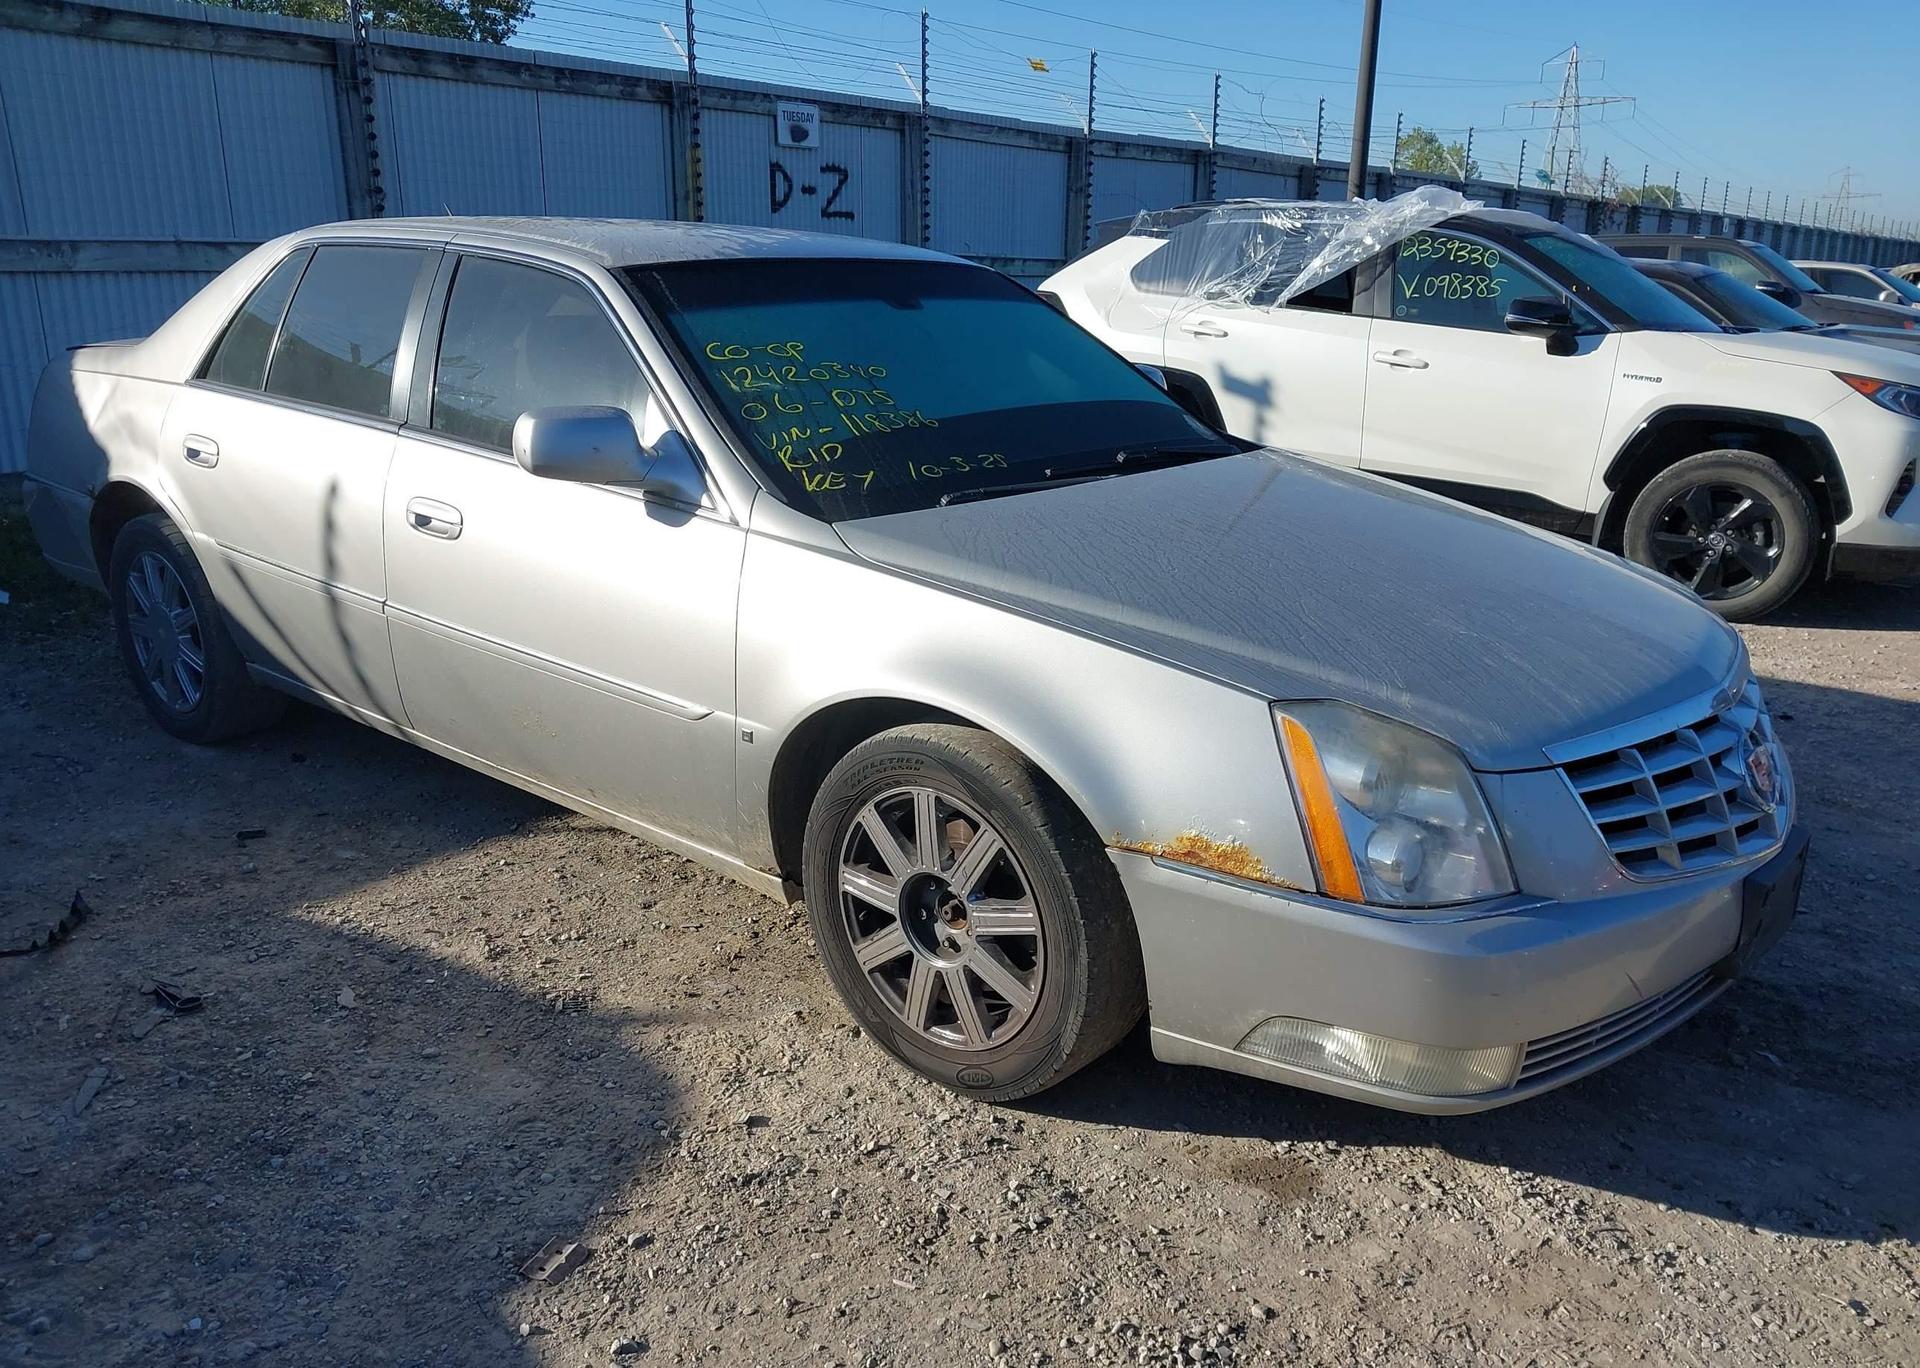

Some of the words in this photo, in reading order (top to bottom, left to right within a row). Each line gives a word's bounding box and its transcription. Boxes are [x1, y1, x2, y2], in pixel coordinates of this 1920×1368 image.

[782, 110, 815, 124] TUESDAY
[1400, 236, 1500, 268] 12359330
[720, 362, 887, 392] 12420340
[1623, 373, 1663, 383] HYBRID
[802, 470, 875, 492] KEY
